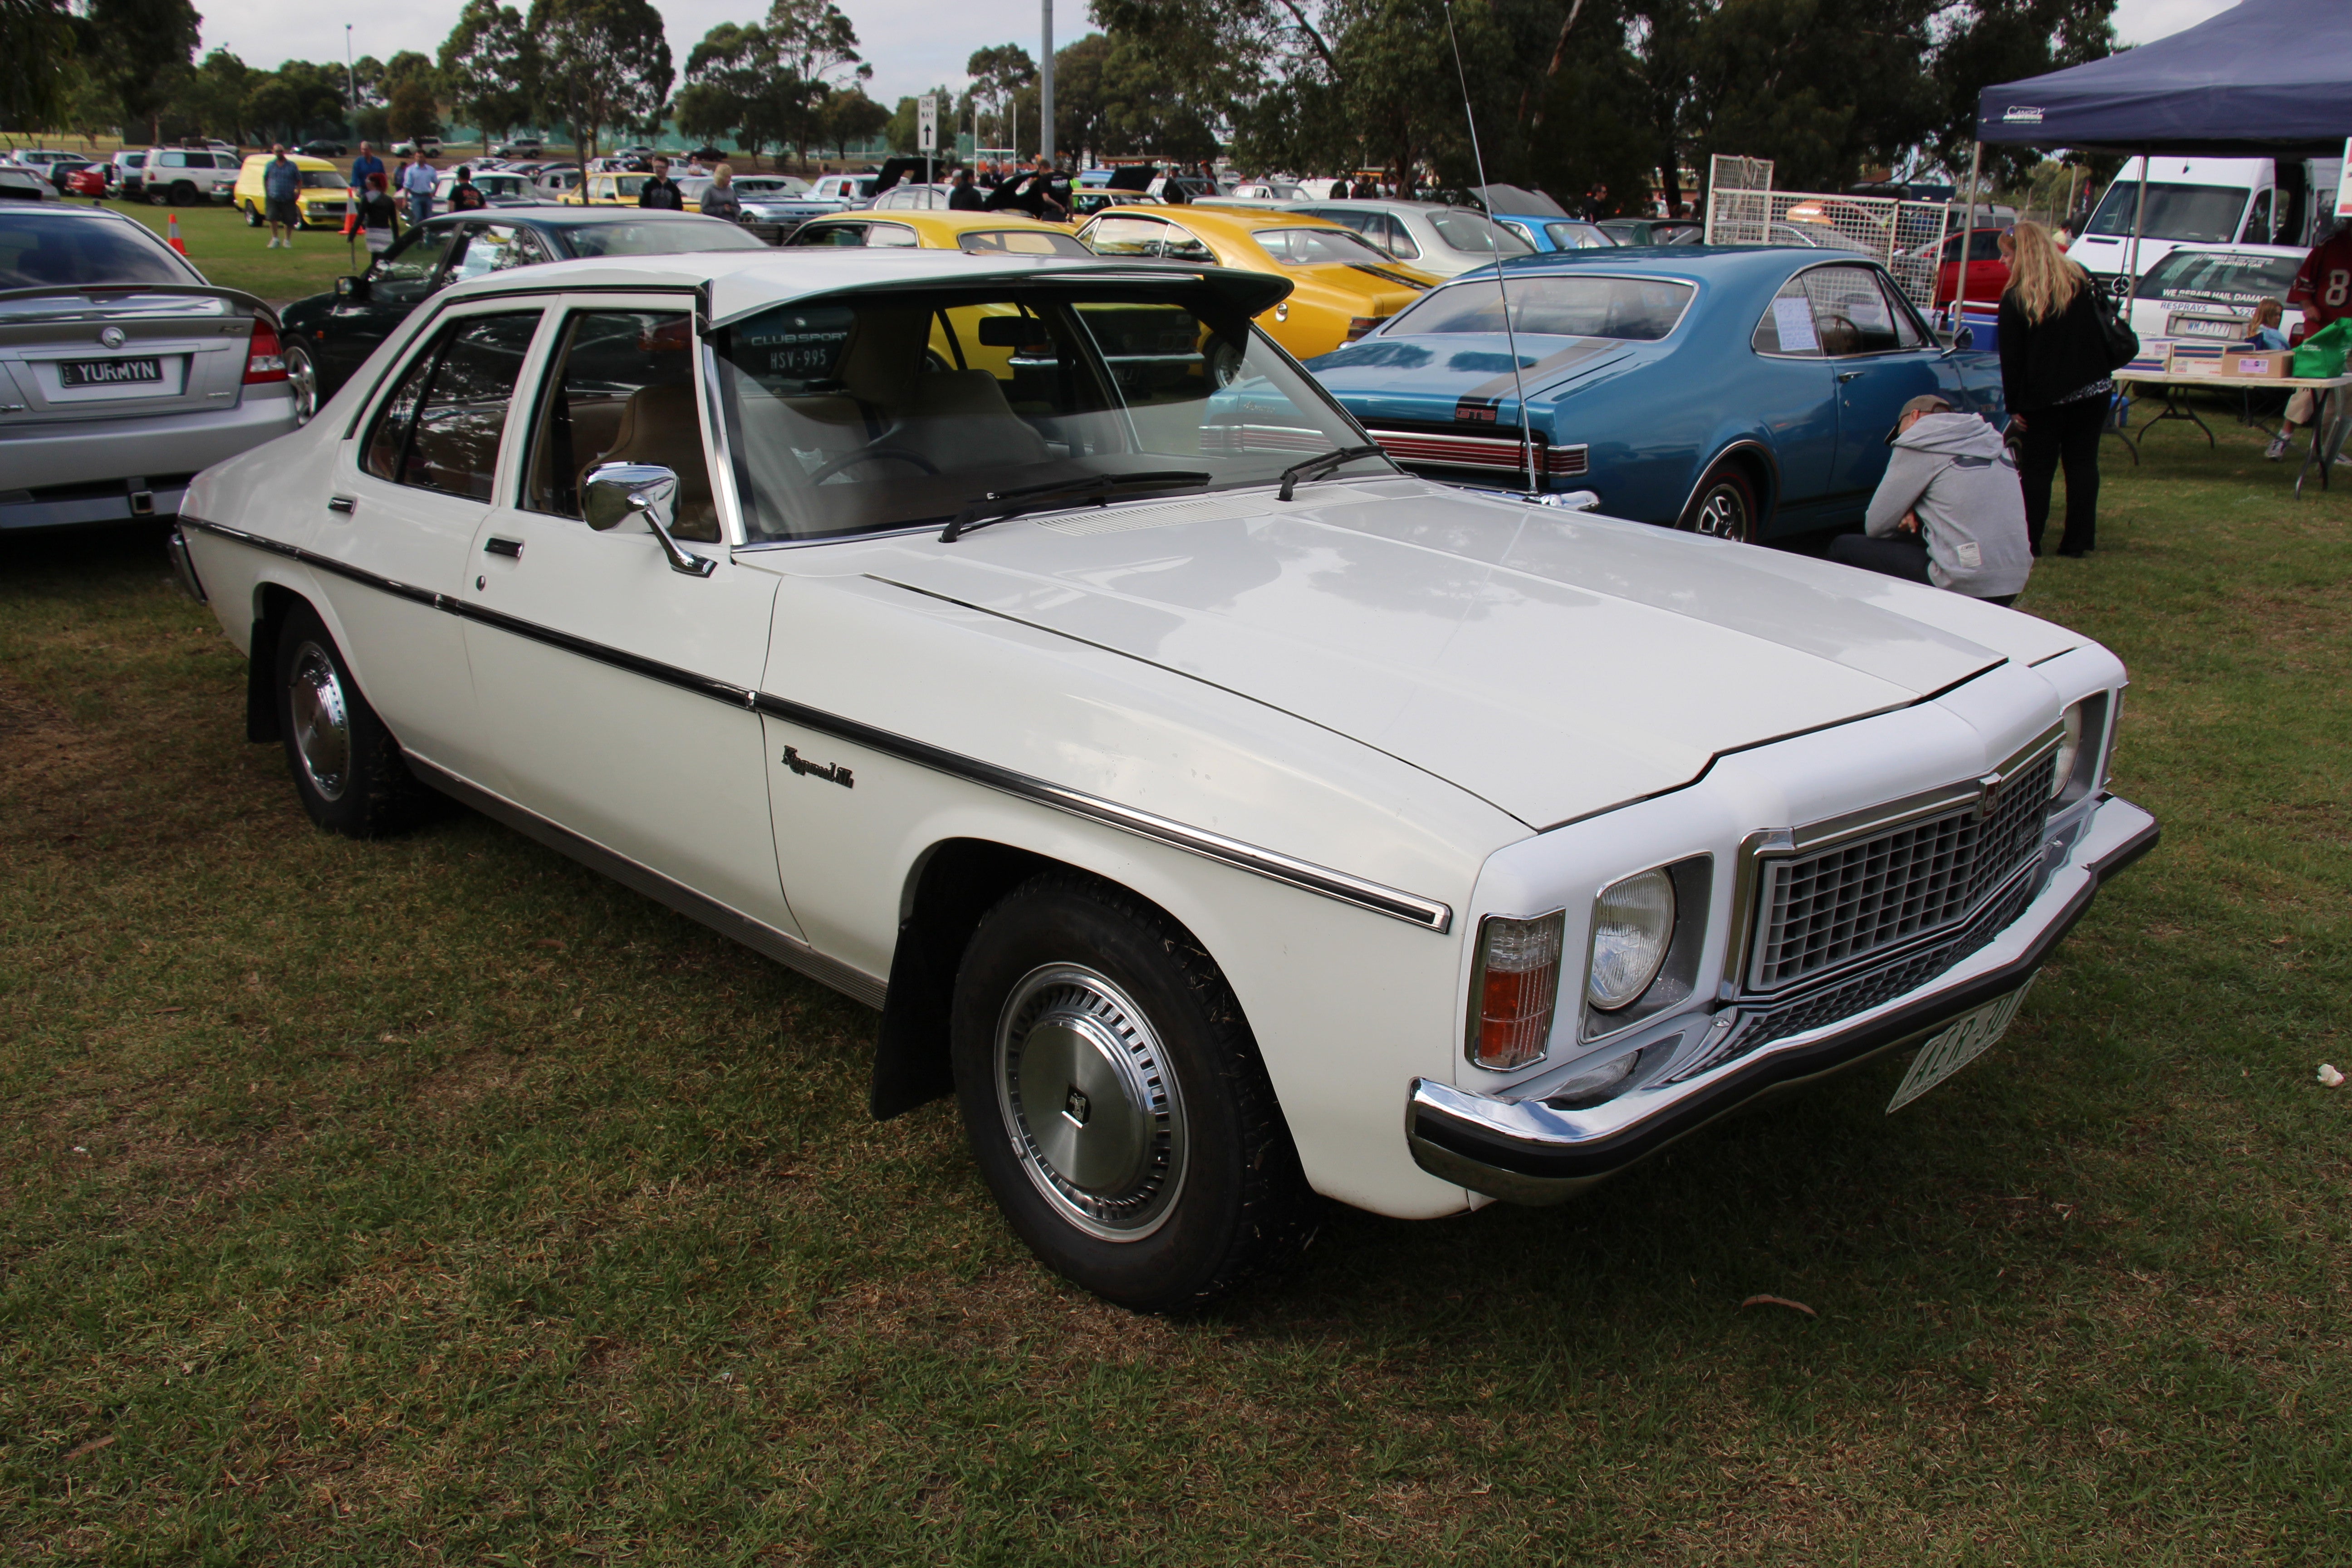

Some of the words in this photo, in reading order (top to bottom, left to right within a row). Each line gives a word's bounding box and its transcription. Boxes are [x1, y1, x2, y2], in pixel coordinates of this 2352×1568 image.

[2211, 292, 2232, 301] HAIL
[2233, 293, 2276, 303] DAMA
[2160, 302, 2208, 312] RESPRAYS
[78, 361, 155, 382] YURMYN
[1456, 408, 1496, 420] GTS
